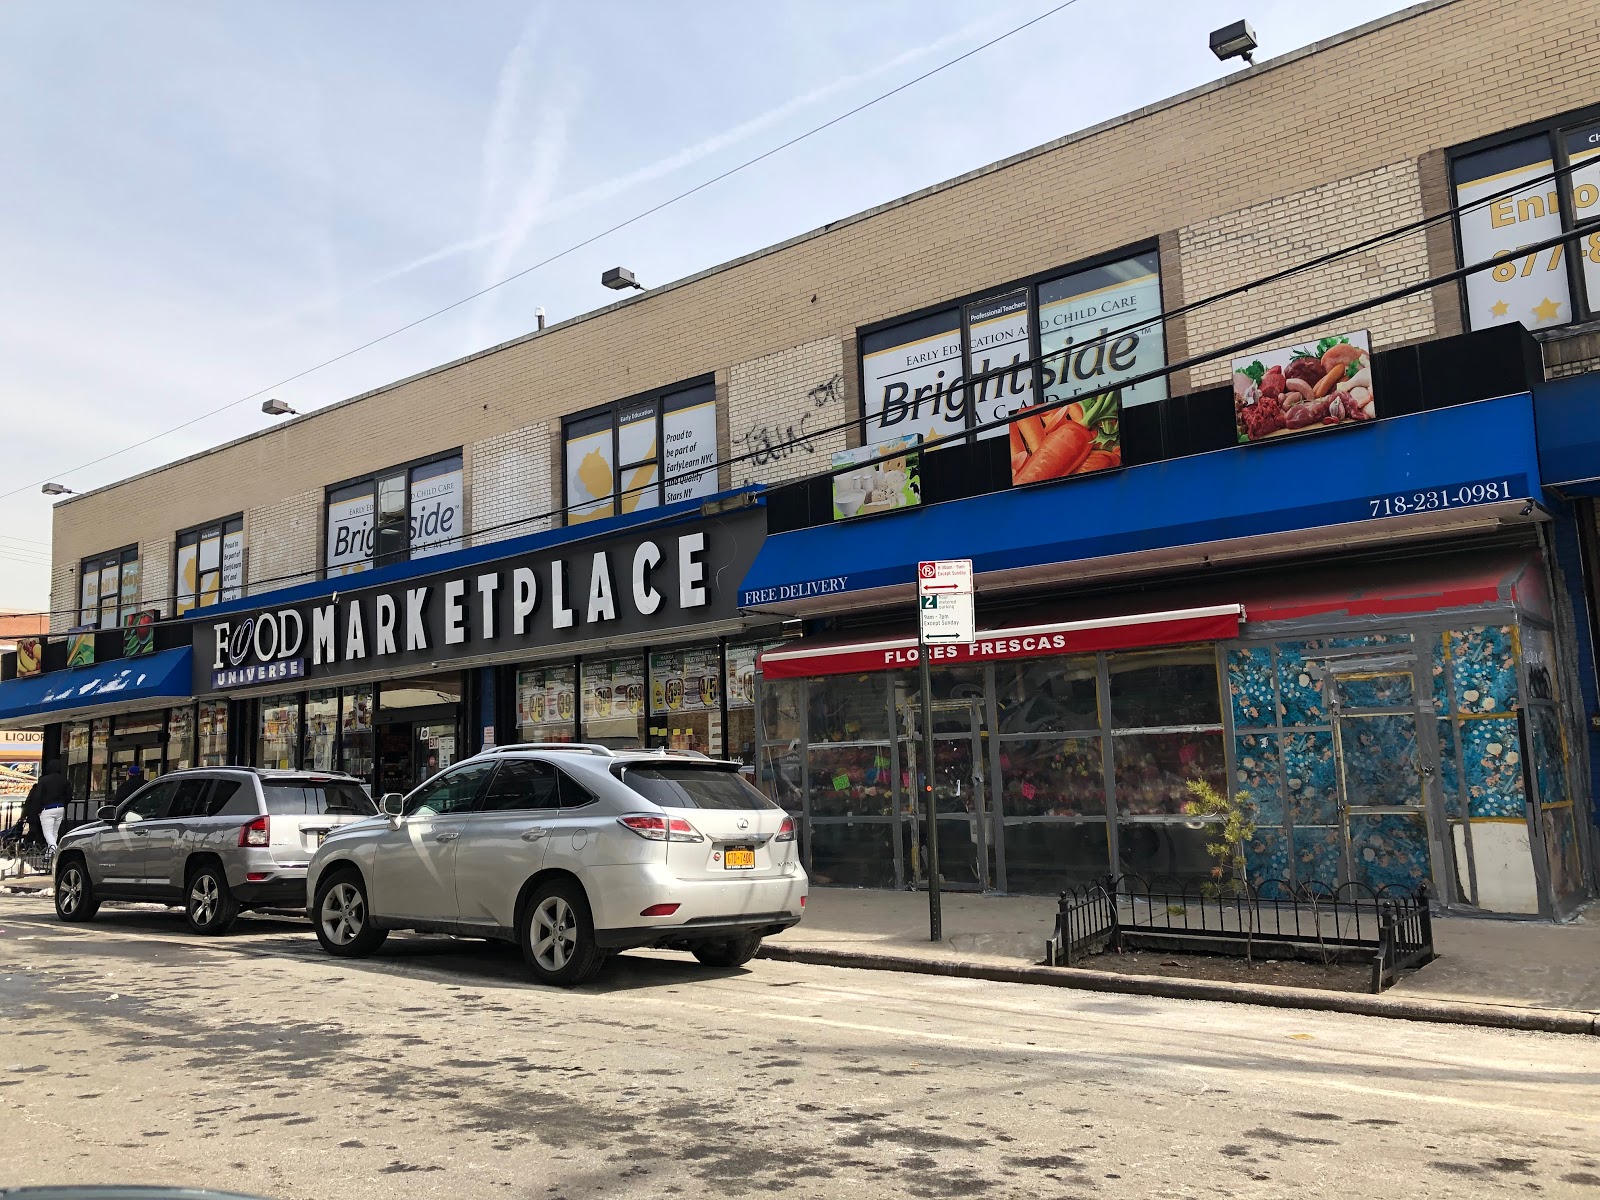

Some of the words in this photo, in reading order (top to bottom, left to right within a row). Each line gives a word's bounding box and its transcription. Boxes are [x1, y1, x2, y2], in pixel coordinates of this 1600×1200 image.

[970, 309, 1002, 322] Professional
[1003, 301, 1026, 312] Teachers
[906, 350, 939, 367] EARLY
[1017, 316, 1050, 335] AD
[1053, 305, 1098, 327] CHILD
[1101, 294, 1138, 314] CARE
[880, 327, 1140, 429] Brightside
[632, 408, 654, 420] Education
[665, 430, 685, 443] Proud
[685, 429, 693, 438] to
[665, 448, 674, 458] be
[674, 444, 689, 458] part
[689, 441, 698, 452] of
[666, 457, 700, 473] EarlyLearn
[700, 452, 714, 464] NYC
[666, 491, 683, 502] Stars
[683, 488, 693, 499] NY
[1369, 480, 1512, 517] 718-231-0981
[312, 533, 707, 664] MARKETPLACE
[745, 588, 777, 605] FREE
[780, 576, 848, 599] DELIVERY
[925, 596, 934, 608] 2
[213, 609, 303, 669] FOOD
[969, 634, 1066, 656] FRESCAS
[217, 661, 299, 686] UNIVERSE
